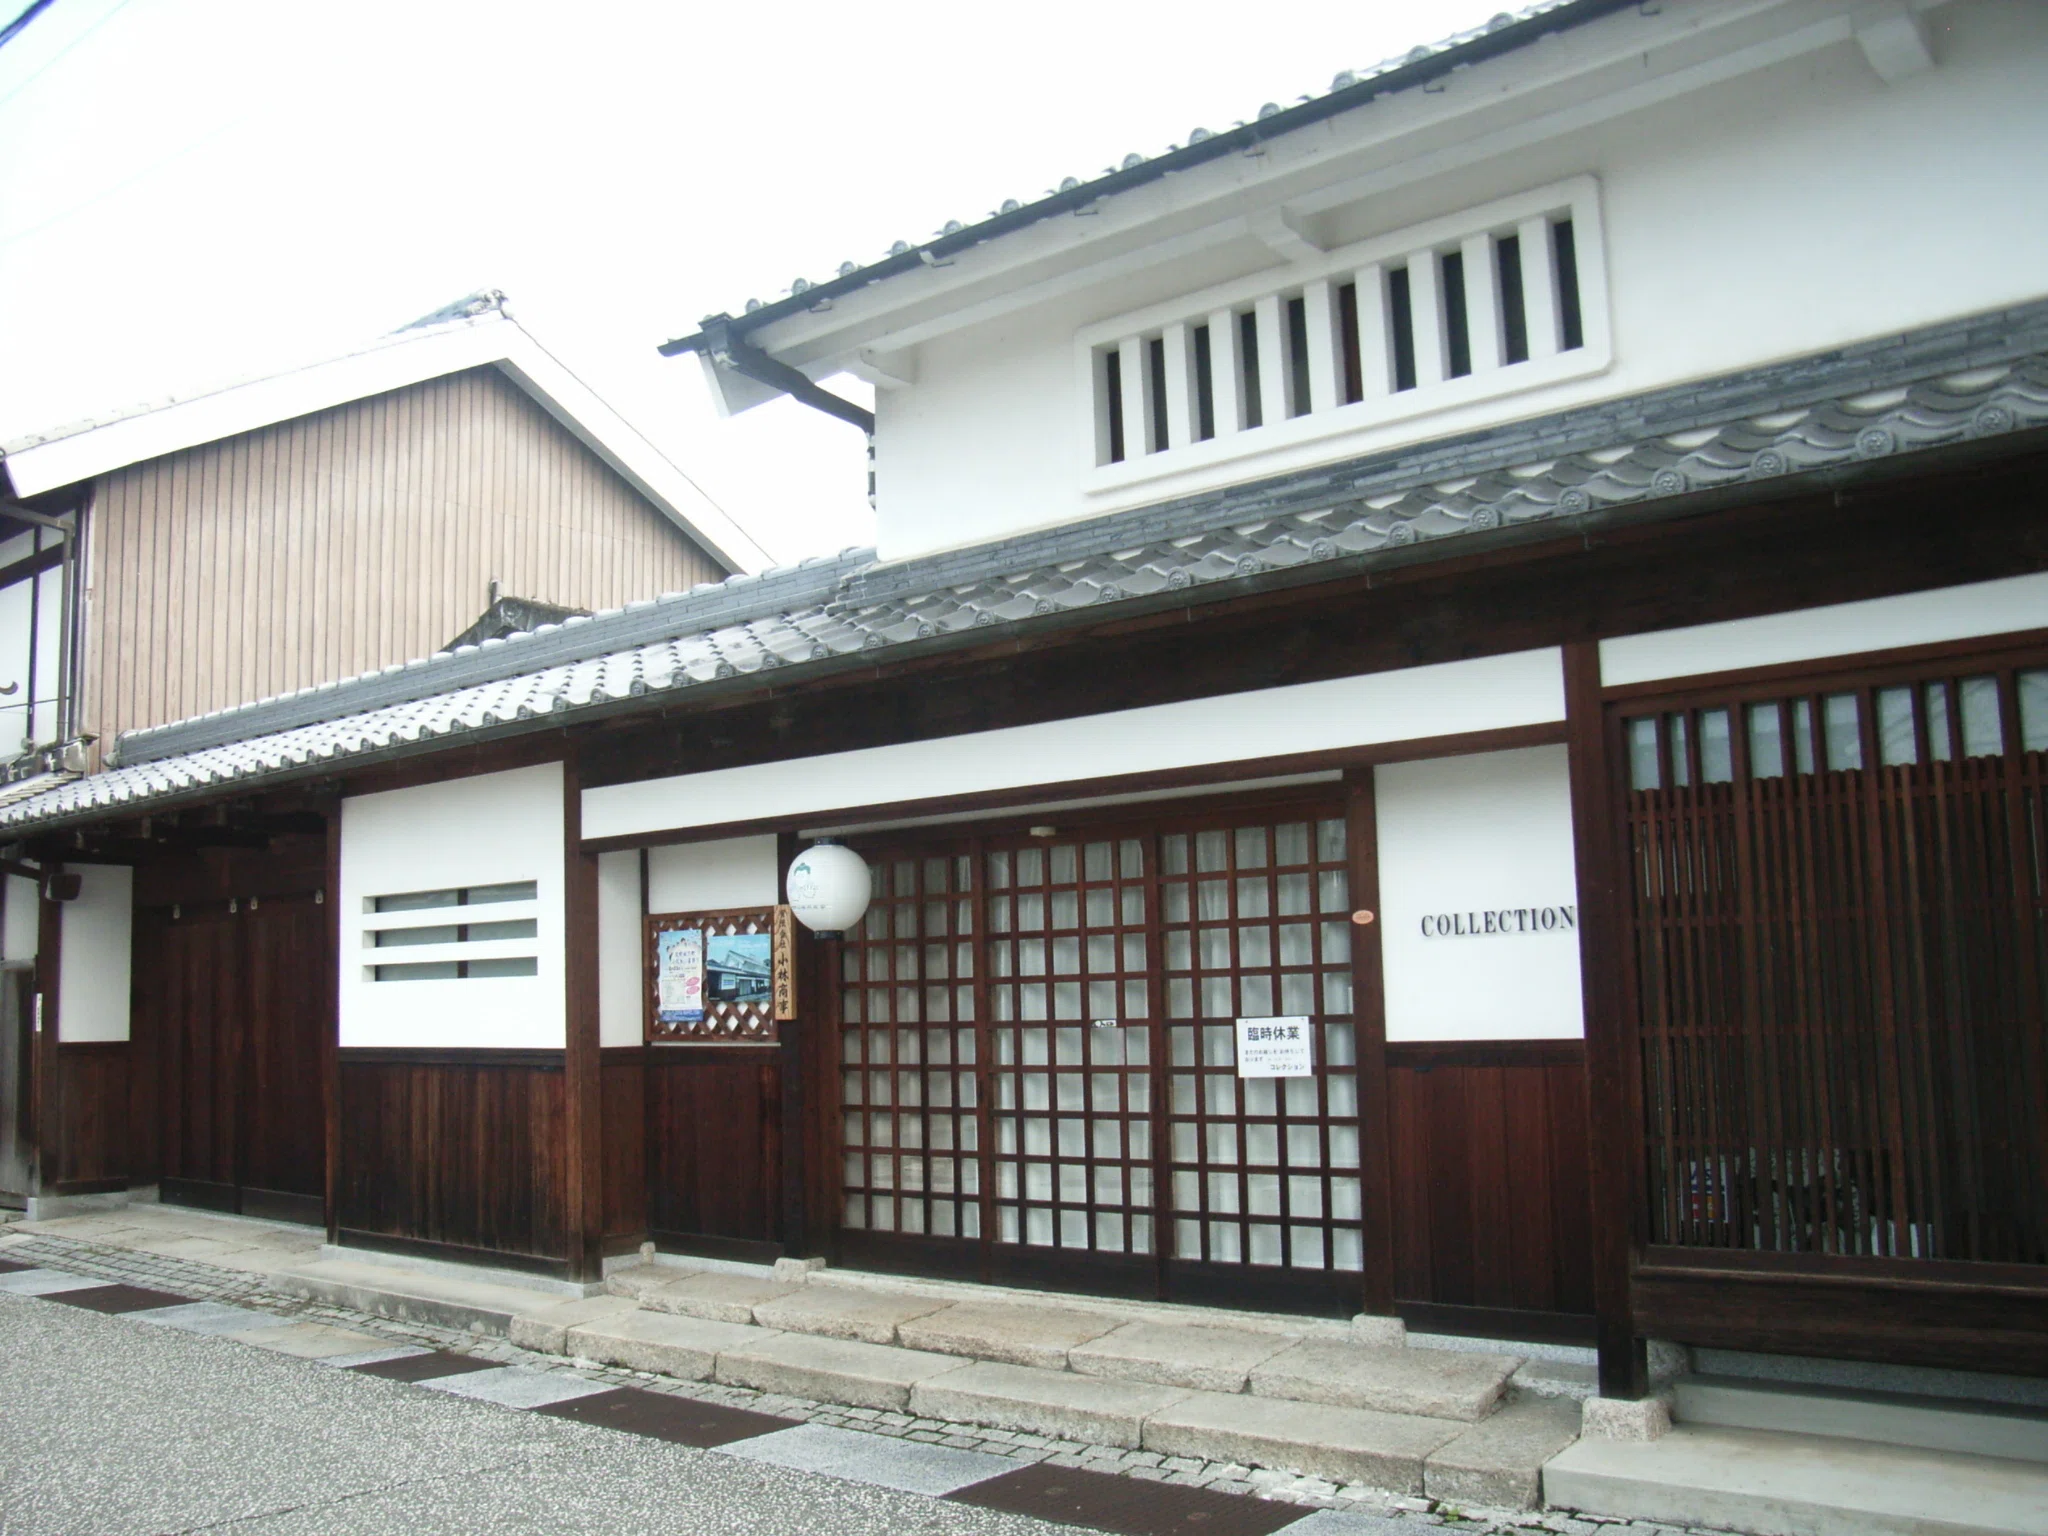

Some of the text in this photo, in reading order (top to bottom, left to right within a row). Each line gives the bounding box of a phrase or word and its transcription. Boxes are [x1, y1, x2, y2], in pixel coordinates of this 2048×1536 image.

[1421, 905, 1576, 937] COLLECTION
[1248, 1026, 1299, 1041] 臨時休業
